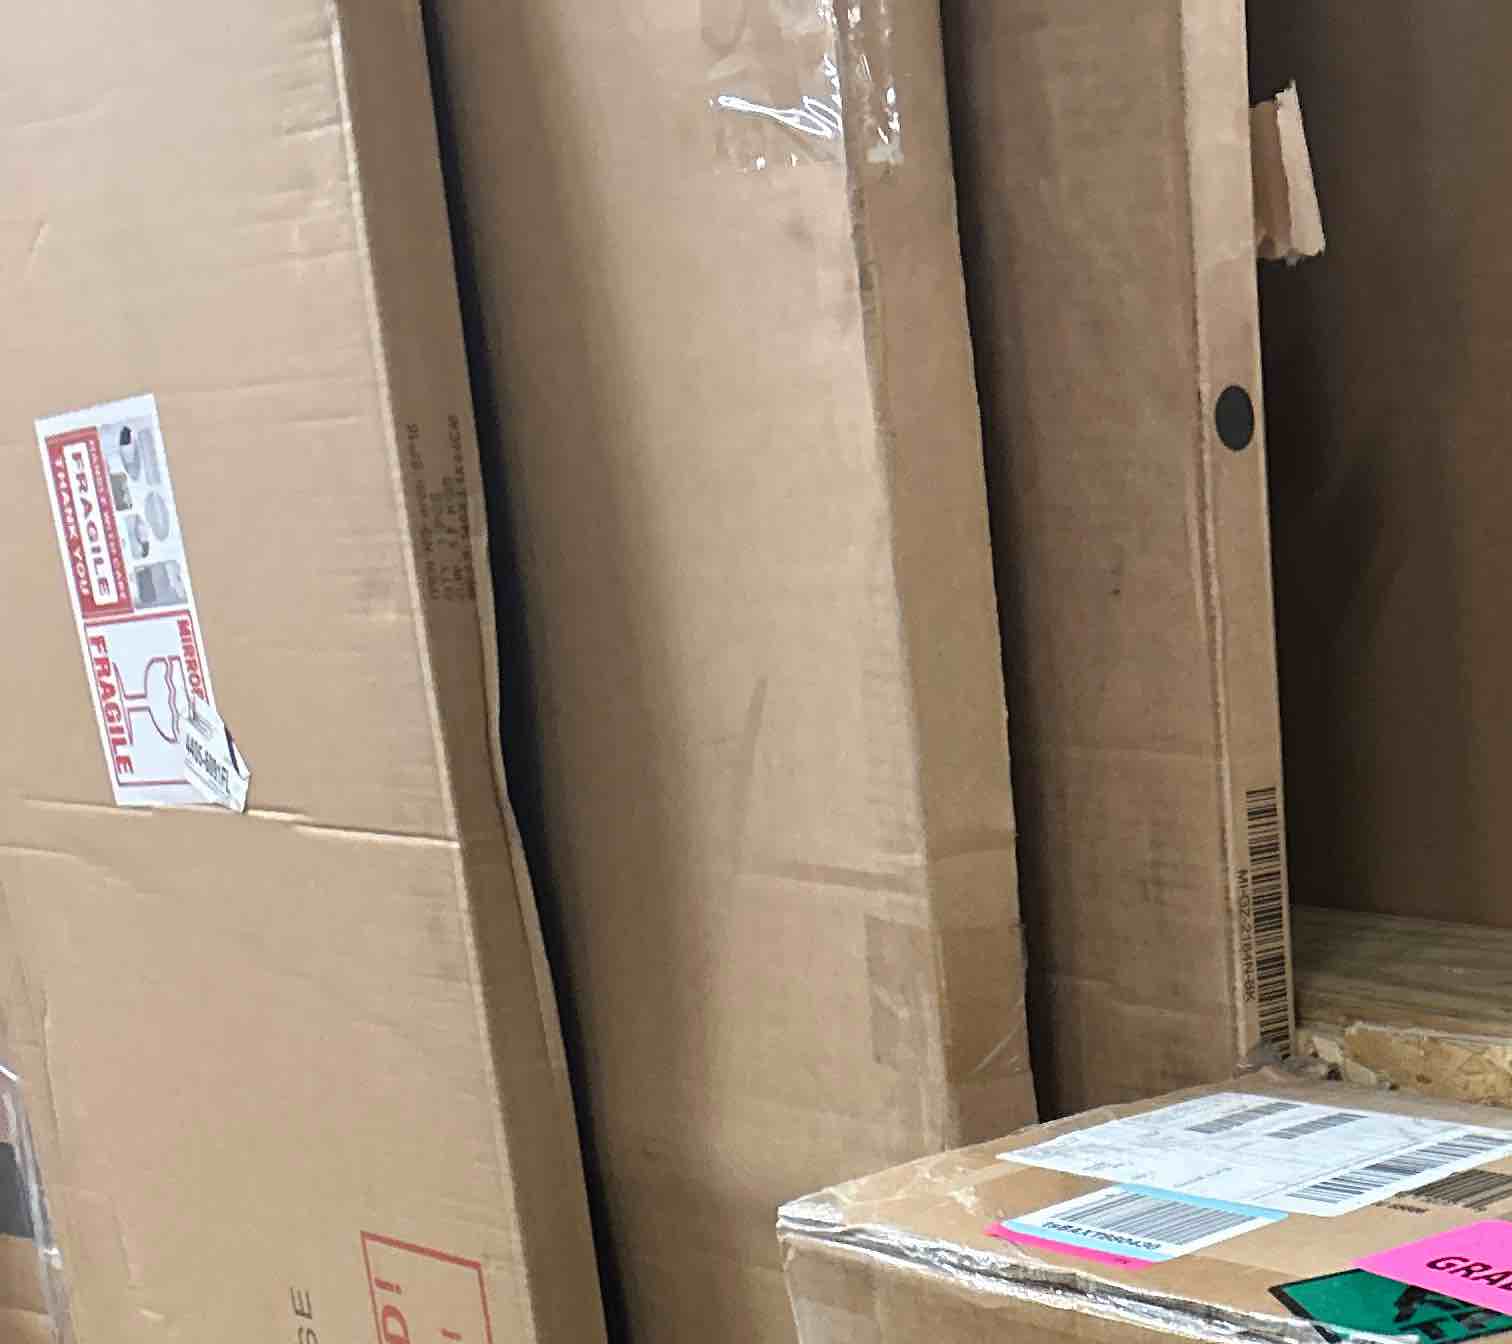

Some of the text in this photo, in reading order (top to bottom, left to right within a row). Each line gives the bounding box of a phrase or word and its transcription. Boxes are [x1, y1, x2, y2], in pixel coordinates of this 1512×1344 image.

[54, 457, 90, 597] THANK YOU
[72, 452, 111, 597] FRAGILE
[88, 635, 134, 775] FRAGILE
